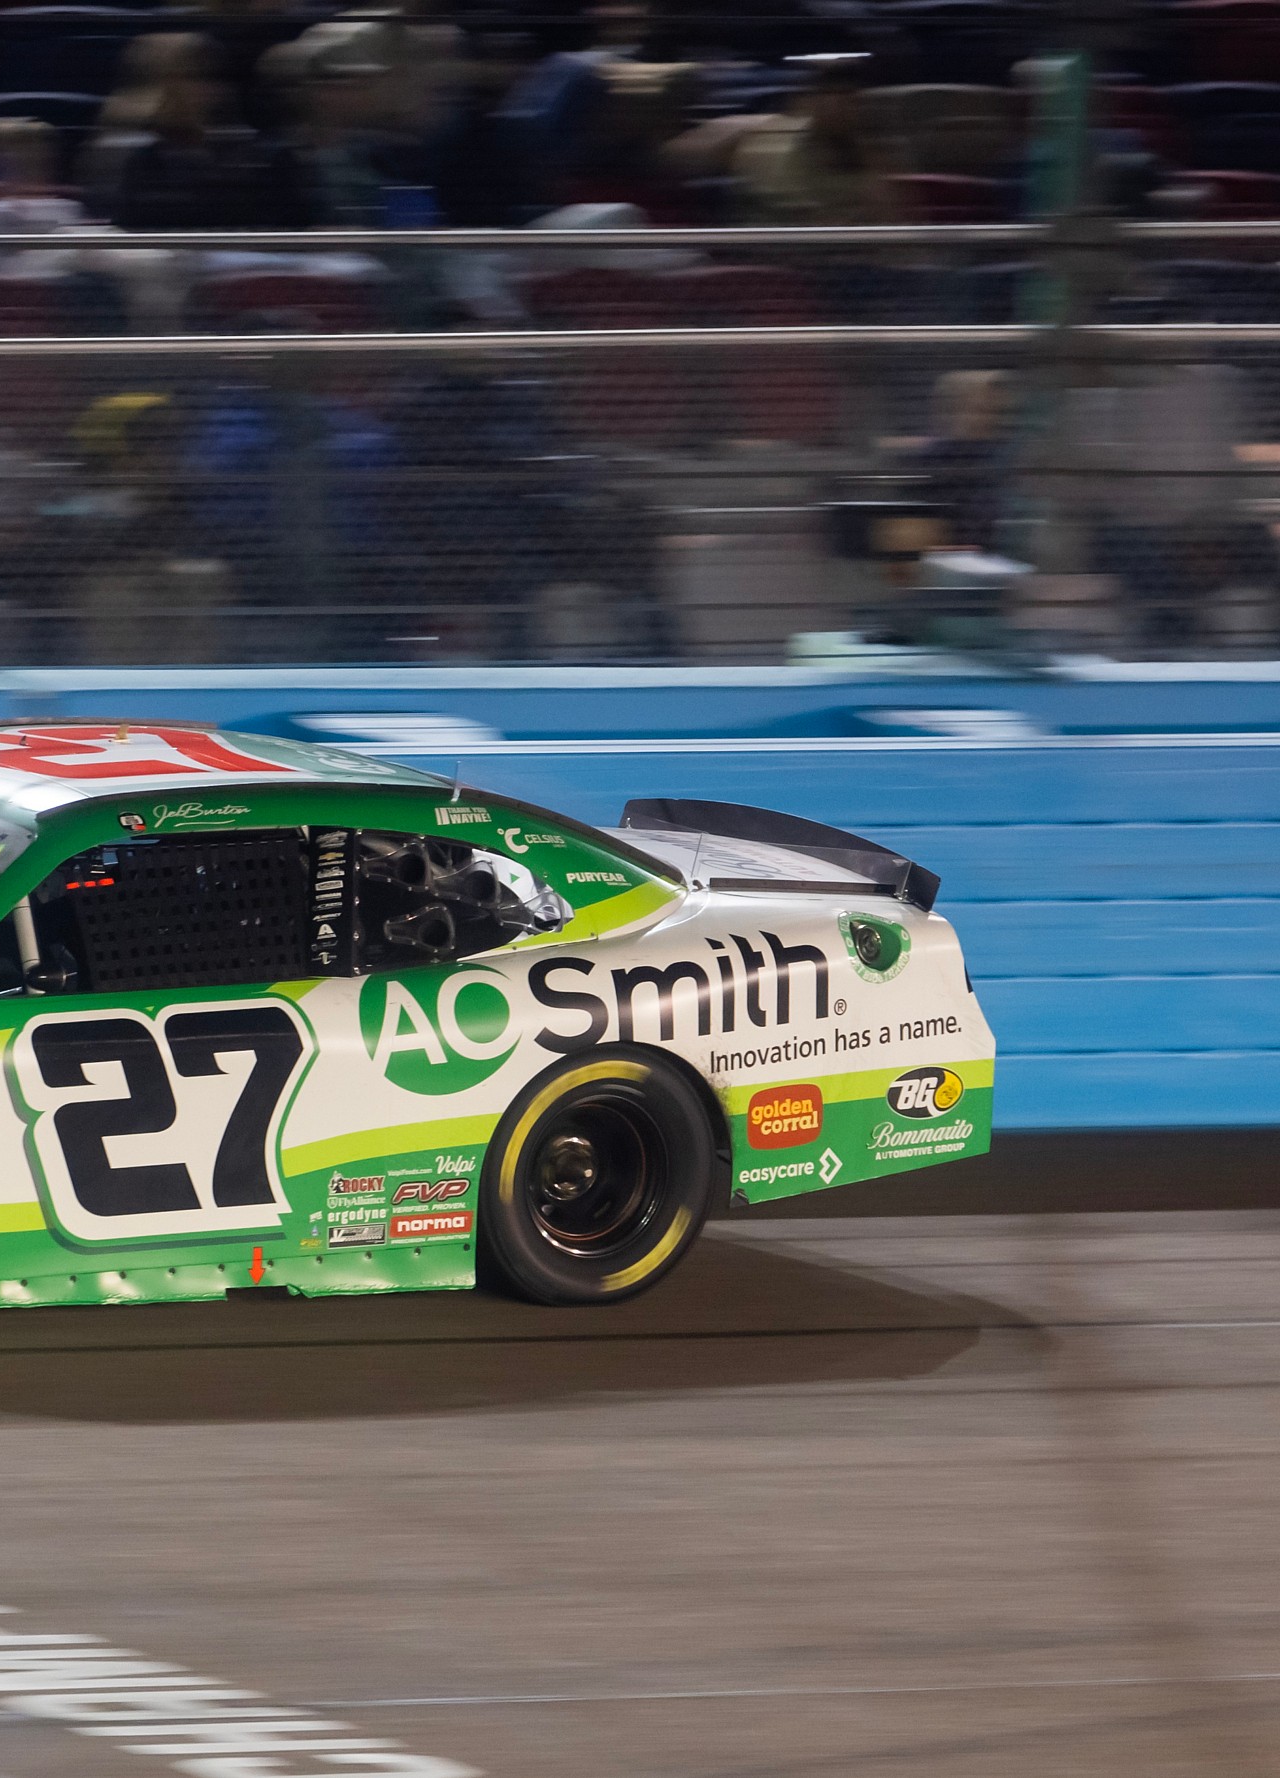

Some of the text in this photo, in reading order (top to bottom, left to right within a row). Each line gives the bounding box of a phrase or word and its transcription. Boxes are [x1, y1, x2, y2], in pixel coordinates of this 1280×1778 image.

[450, 812, 492, 824] WAYNE!
[524, 834, 565, 844] CELSIUS
[566, 872, 627, 884] PURYEAR
[368, 930, 830, 1075] AO Smith
[710, 1015, 963, 1074] Innovation has a name.
[891, 1076, 939, 1111] BG
[31, 1006, 304, 1217] 27
[751, 1098, 814, 1125] golden
[761, 1110, 819, 1136] corral
[866, 1119, 974, 1150] Bommarito
[875, 1142, 966, 1161] AUTOMOTIVE GROUP
[435, 1155, 476, 1176] Volpi
[739, 1161, 815, 1184] easycare
[343, 1176, 385, 1193] ROCKY
[391, 1178, 471, 1205] FVP
[328, 1208, 387, 1224] ergodyne
[397, 1216, 466, 1233] norma
